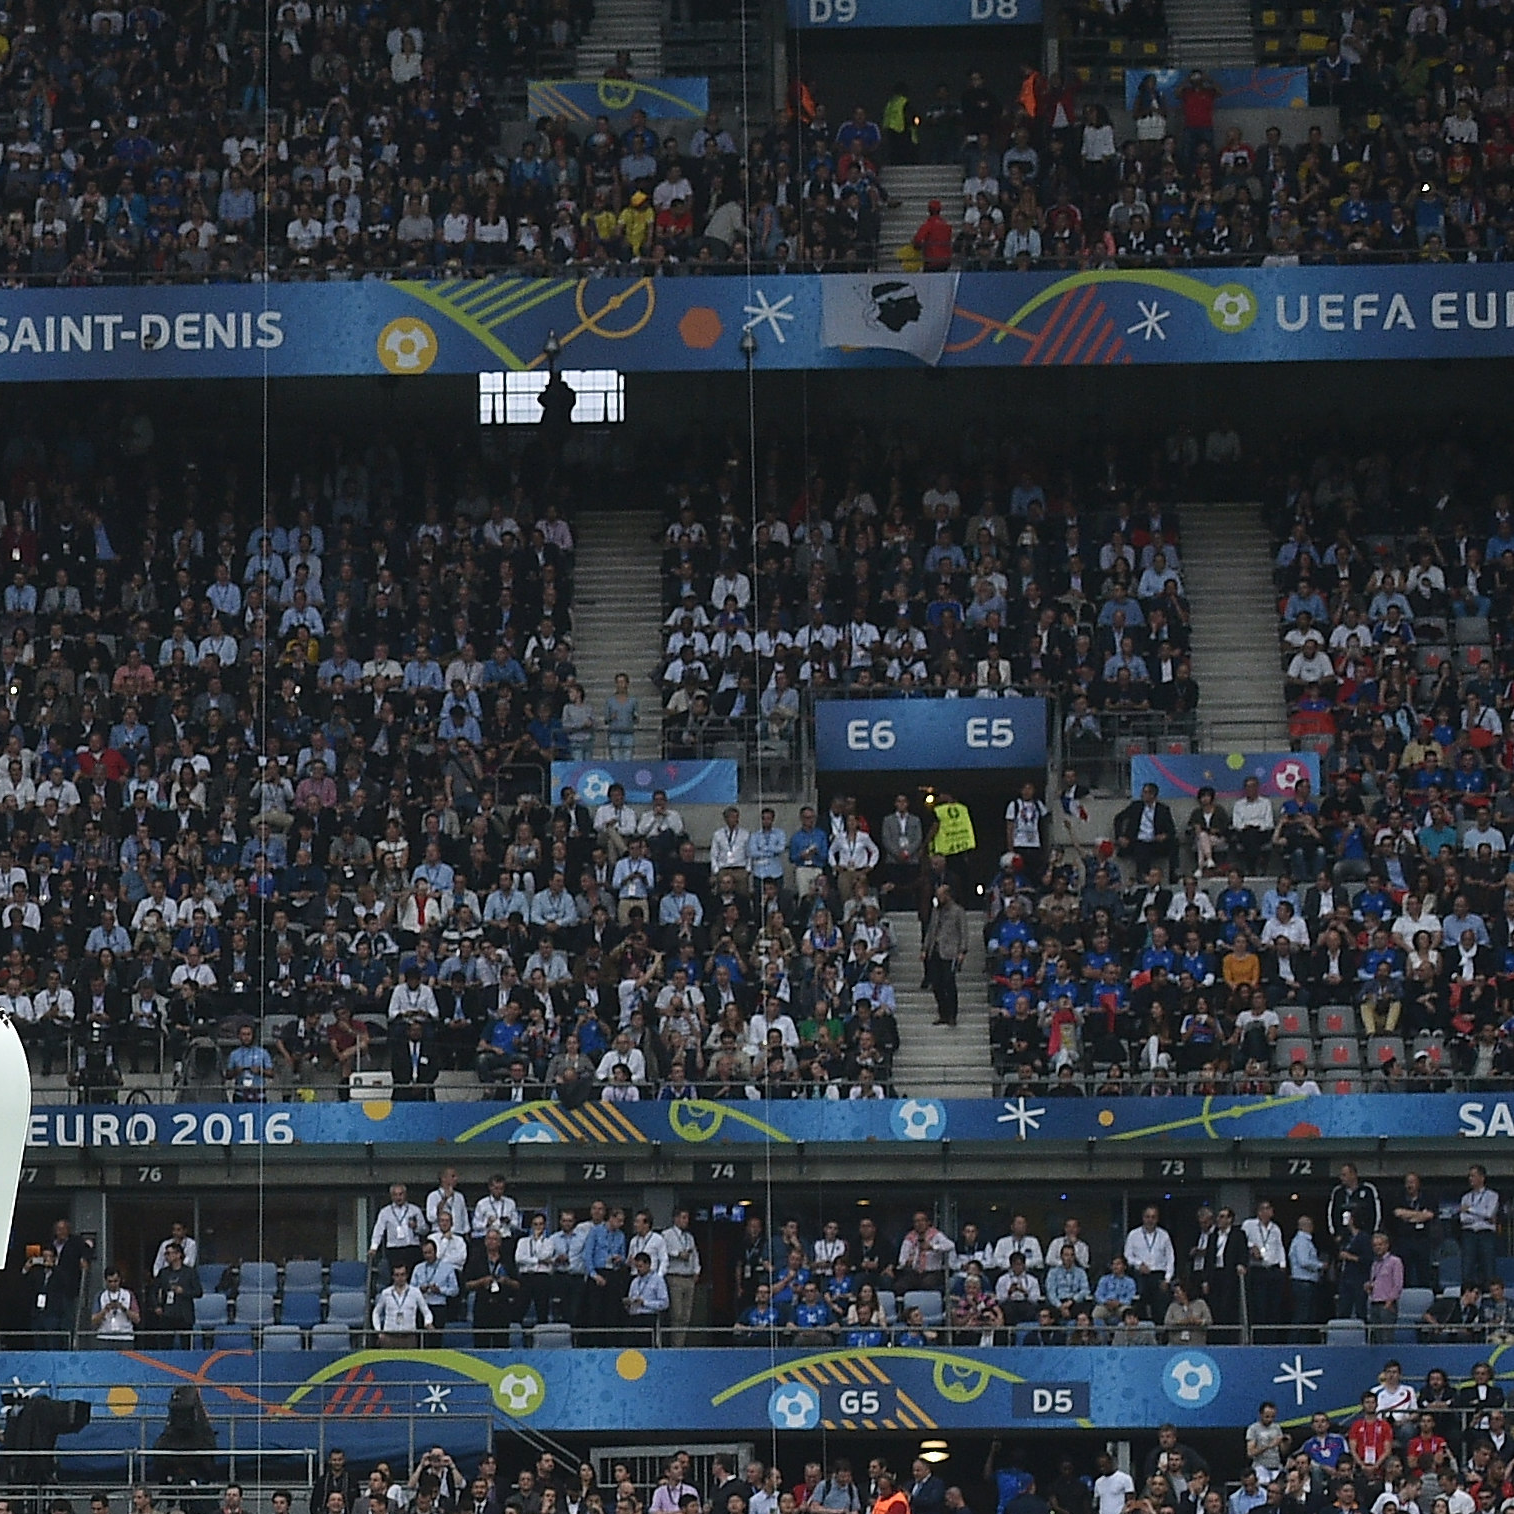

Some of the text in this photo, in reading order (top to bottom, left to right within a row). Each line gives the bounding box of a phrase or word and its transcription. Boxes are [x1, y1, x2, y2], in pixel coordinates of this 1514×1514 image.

[1275, 293, 1416, 332] UEFA
[847, 719, 896, 750] E6
[966, 717, 1014, 748] E5
[27, 1112, 294, 1146] EURO 2016
[138, 1167, 162, 1183] 76
[583, 1164, 607, 1180] 75
[712, 1164, 736, 1179] 74
[1161, 1160, 1185, 1176] 73
[1289, 1159, 1312, 1175] 72
[839, 1390, 880, 1415] G5
[1033, 1389, 1073, 1413] D5
